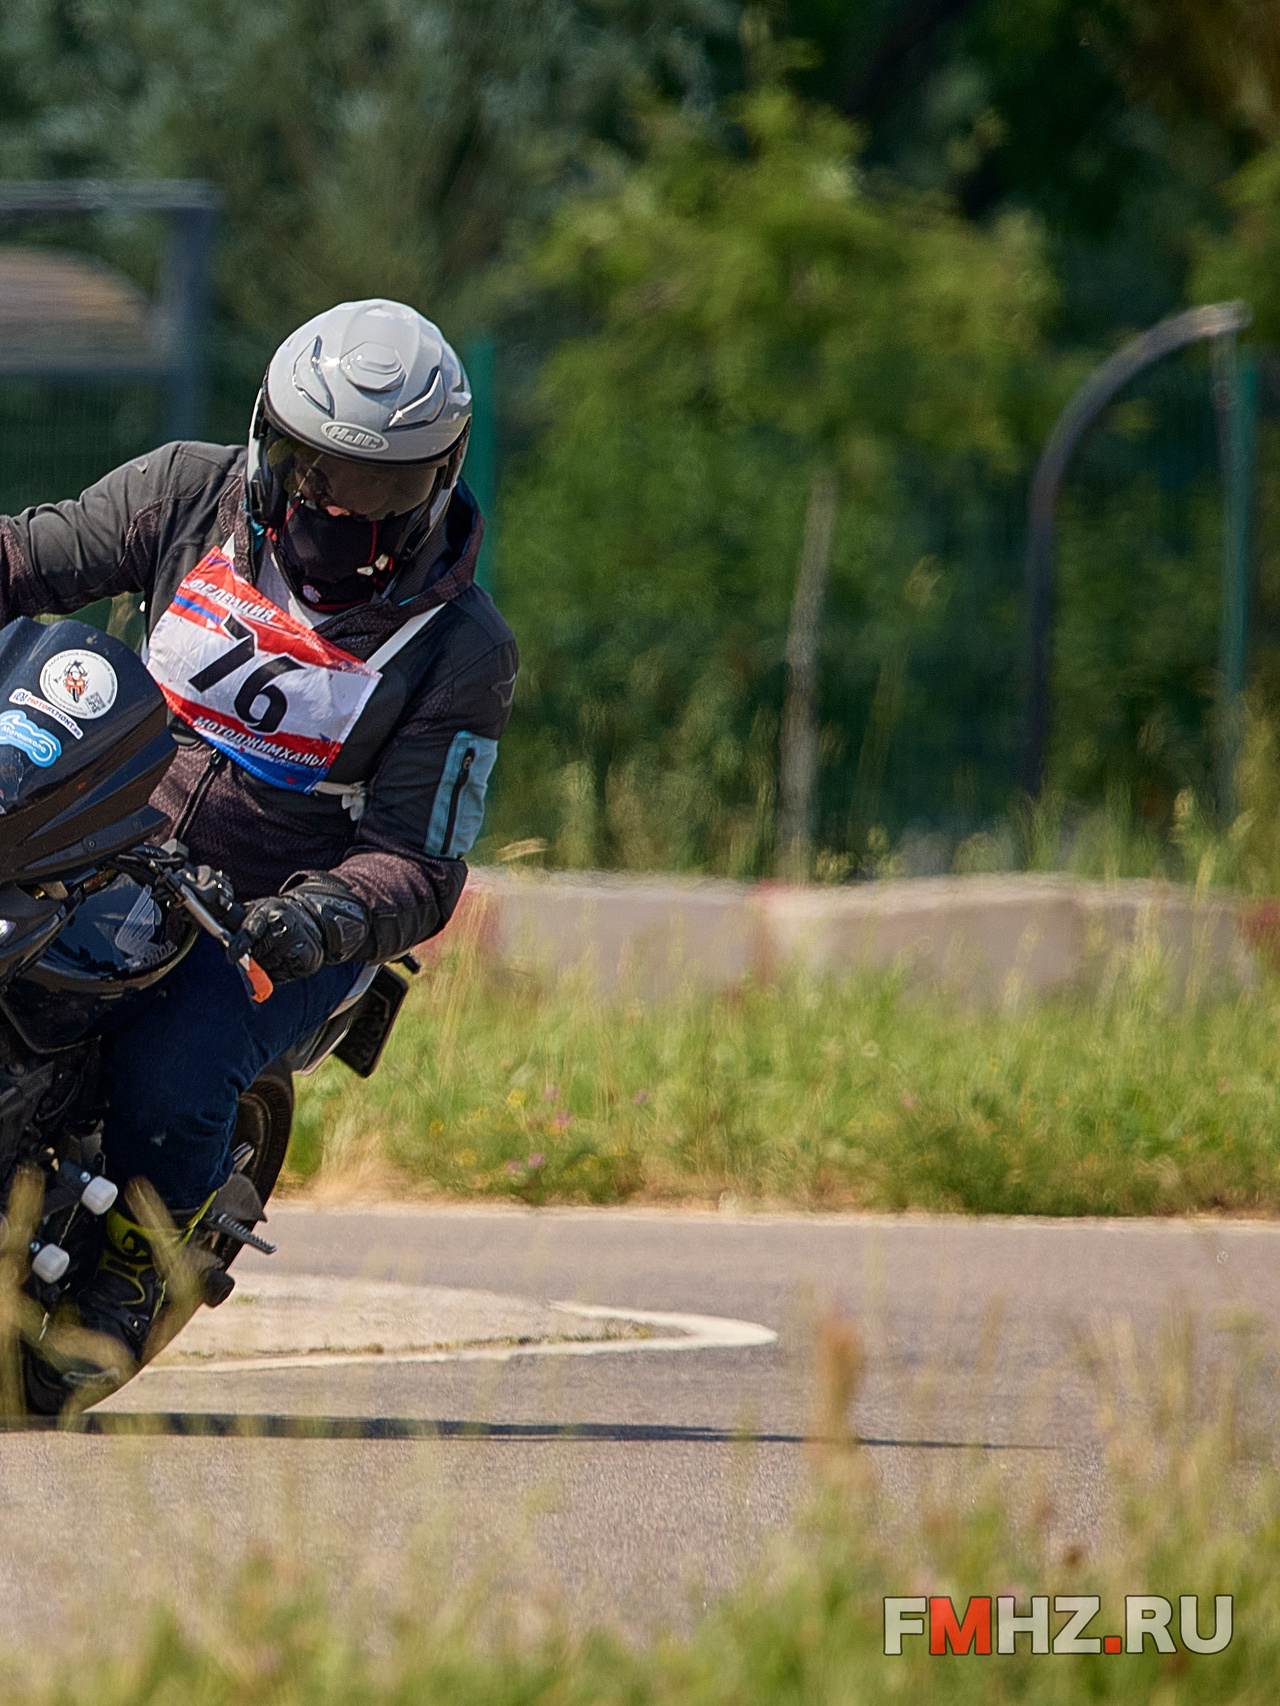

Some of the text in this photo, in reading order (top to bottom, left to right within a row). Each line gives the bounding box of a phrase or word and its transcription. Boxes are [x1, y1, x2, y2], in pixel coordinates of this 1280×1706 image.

[328, 426, 382, 449] HJC
[188, 612, 307, 733] 76
[193, 716, 328, 767] МОТОДЖИМХАНЫ
